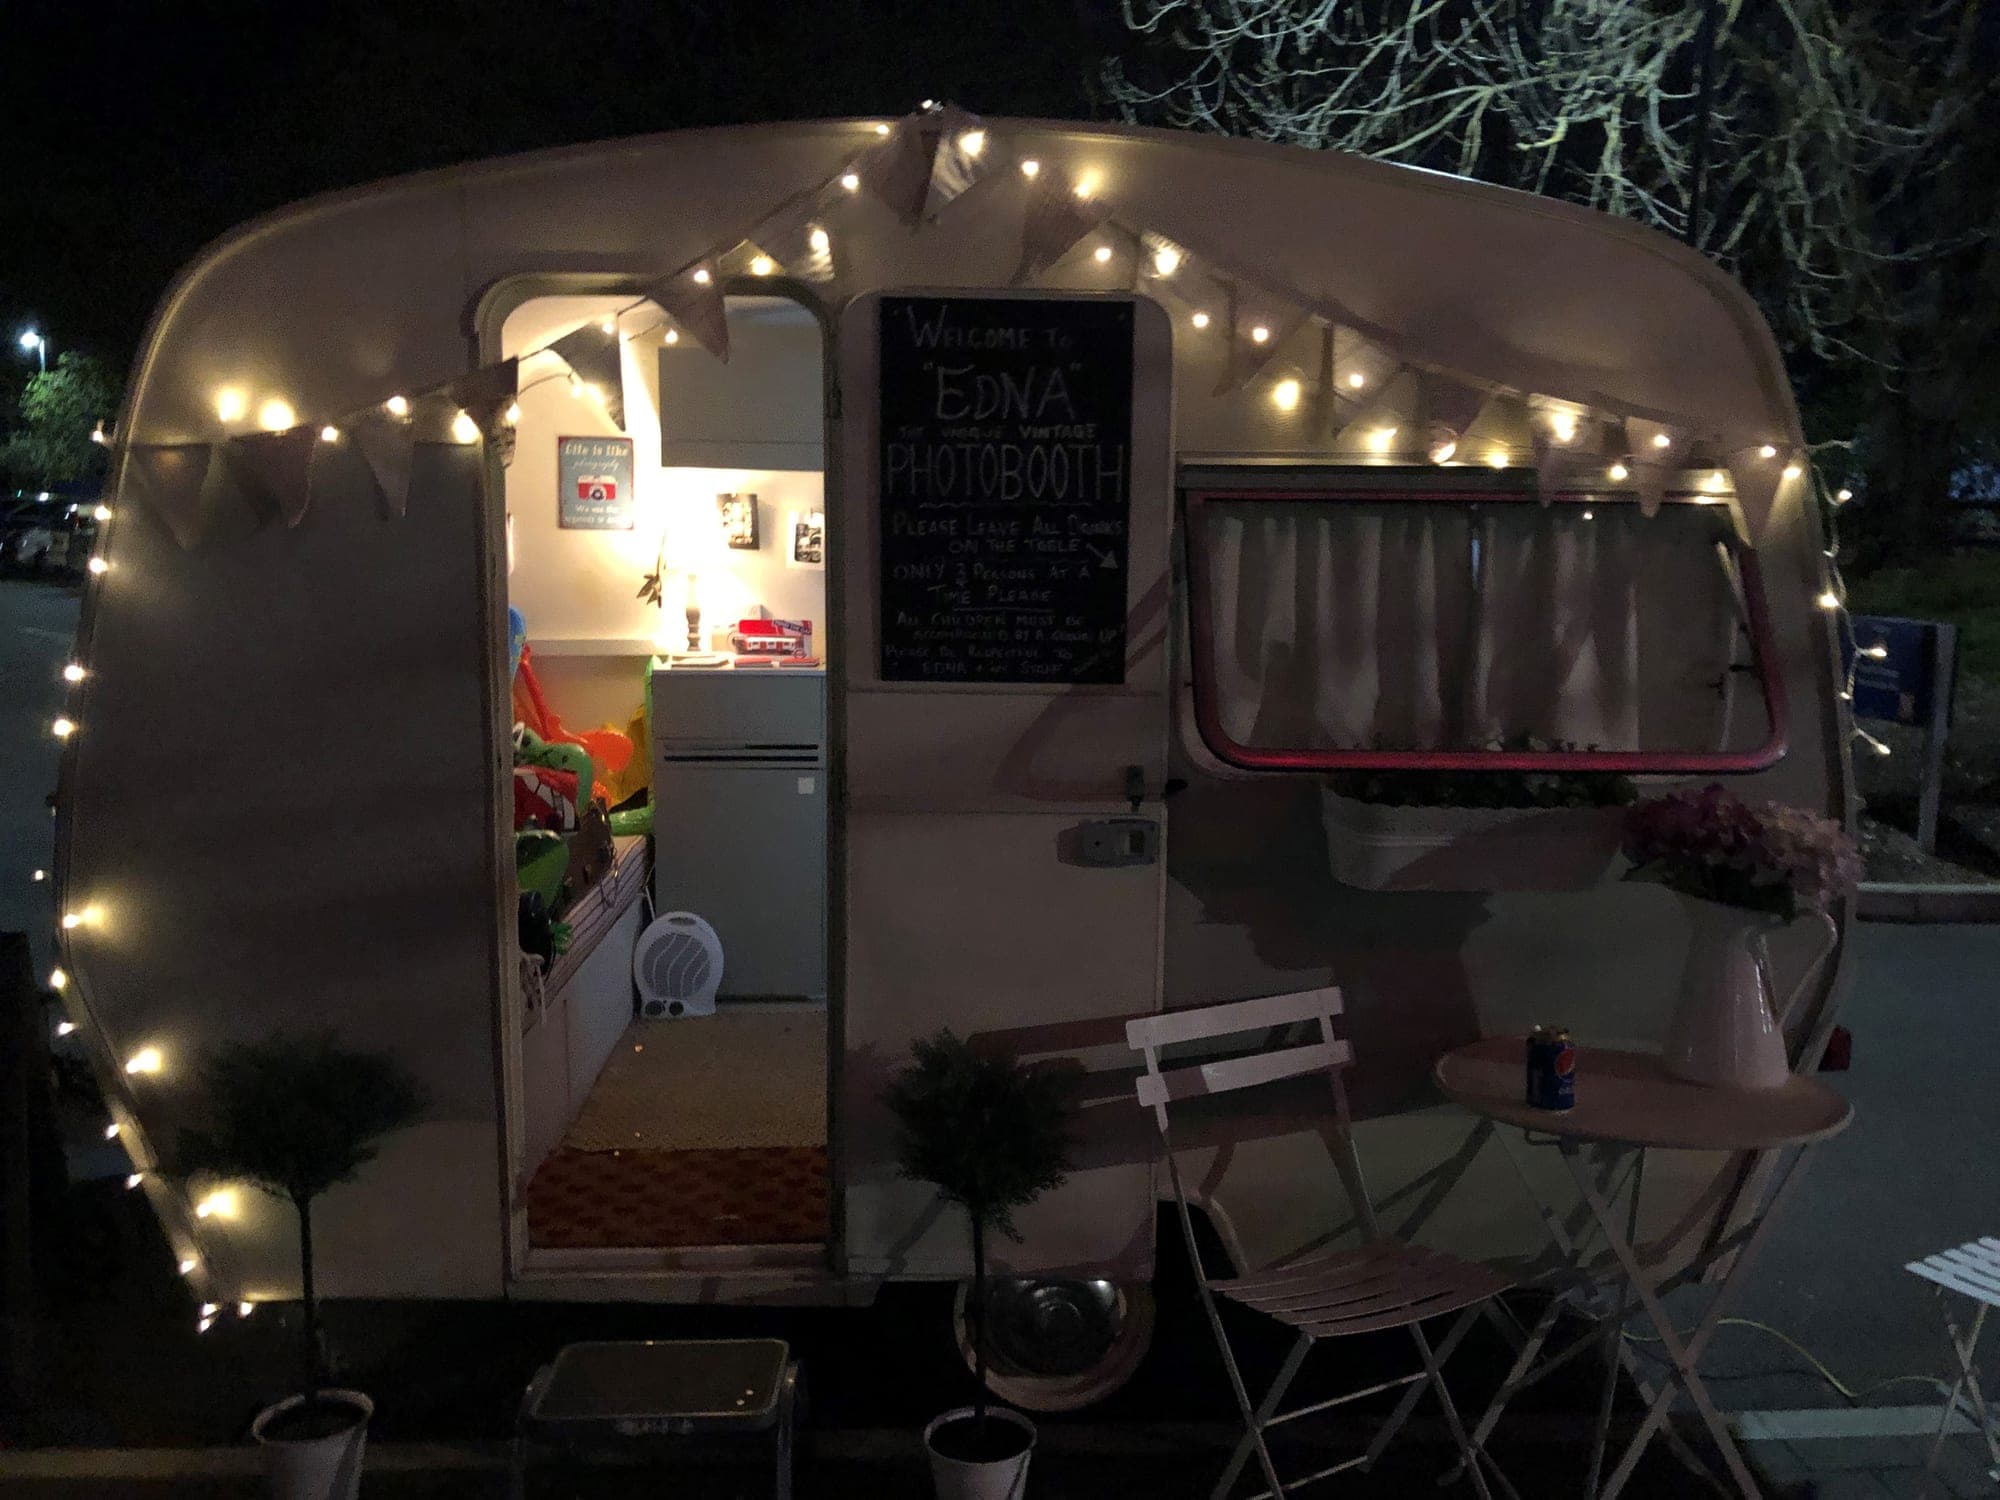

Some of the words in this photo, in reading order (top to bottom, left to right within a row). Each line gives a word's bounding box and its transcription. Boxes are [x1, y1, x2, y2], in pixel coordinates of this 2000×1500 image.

[907, 304, 1032, 349] WELCOME
[1018, 423, 1098, 439] VINTAGE
[887, 442, 1124, 503] PHOTOBOOTH
[893, 510, 959, 536] PLEASE
[967, 511, 1022, 536] LEAVE
[1031, 514, 1061, 535] ALL
[1066, 512, 1124, 536] DRINKS
[948, 539, 980, 554] ON
[985, 538, 1017, 553] THE
[1023, 537, 1082, 553] TABLE
[892, 559, 945, 580] ONLY
[926, 584, 972, 605] TIME
[985, 584, 1053, 603] PLEASE
